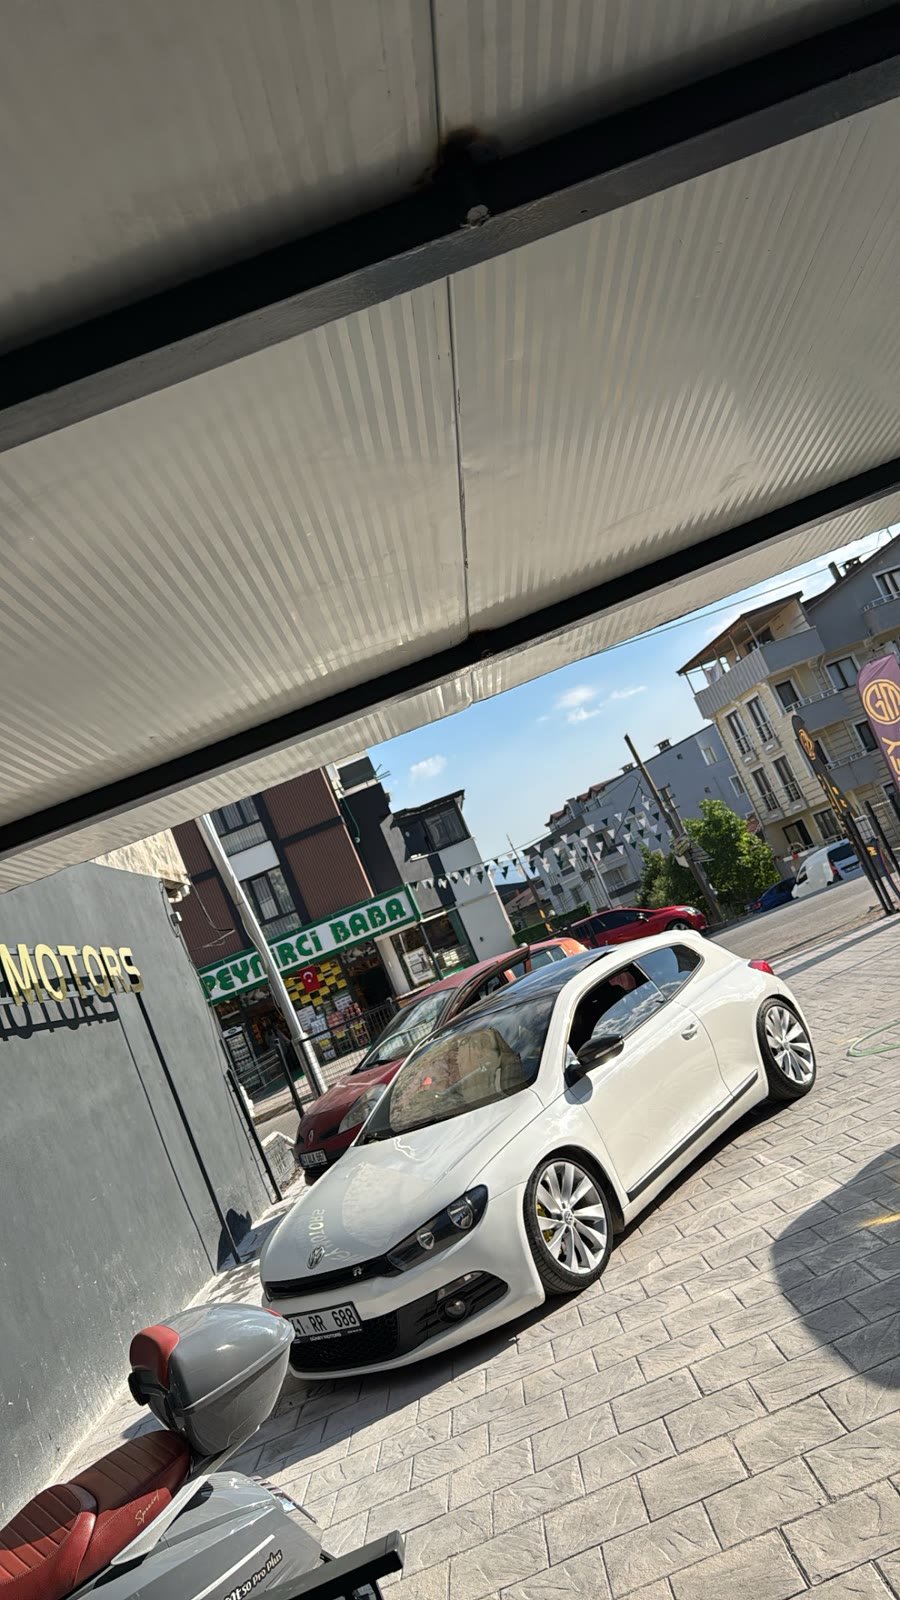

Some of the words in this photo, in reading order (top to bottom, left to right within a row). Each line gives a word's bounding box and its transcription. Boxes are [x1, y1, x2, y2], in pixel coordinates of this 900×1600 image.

[329, 898, 407, 944] BABA
[0, 943, 144, 1006] MOTORS
[308, 1315, 328, 1333] RR
[331, 1307, 357, 1328] 688
